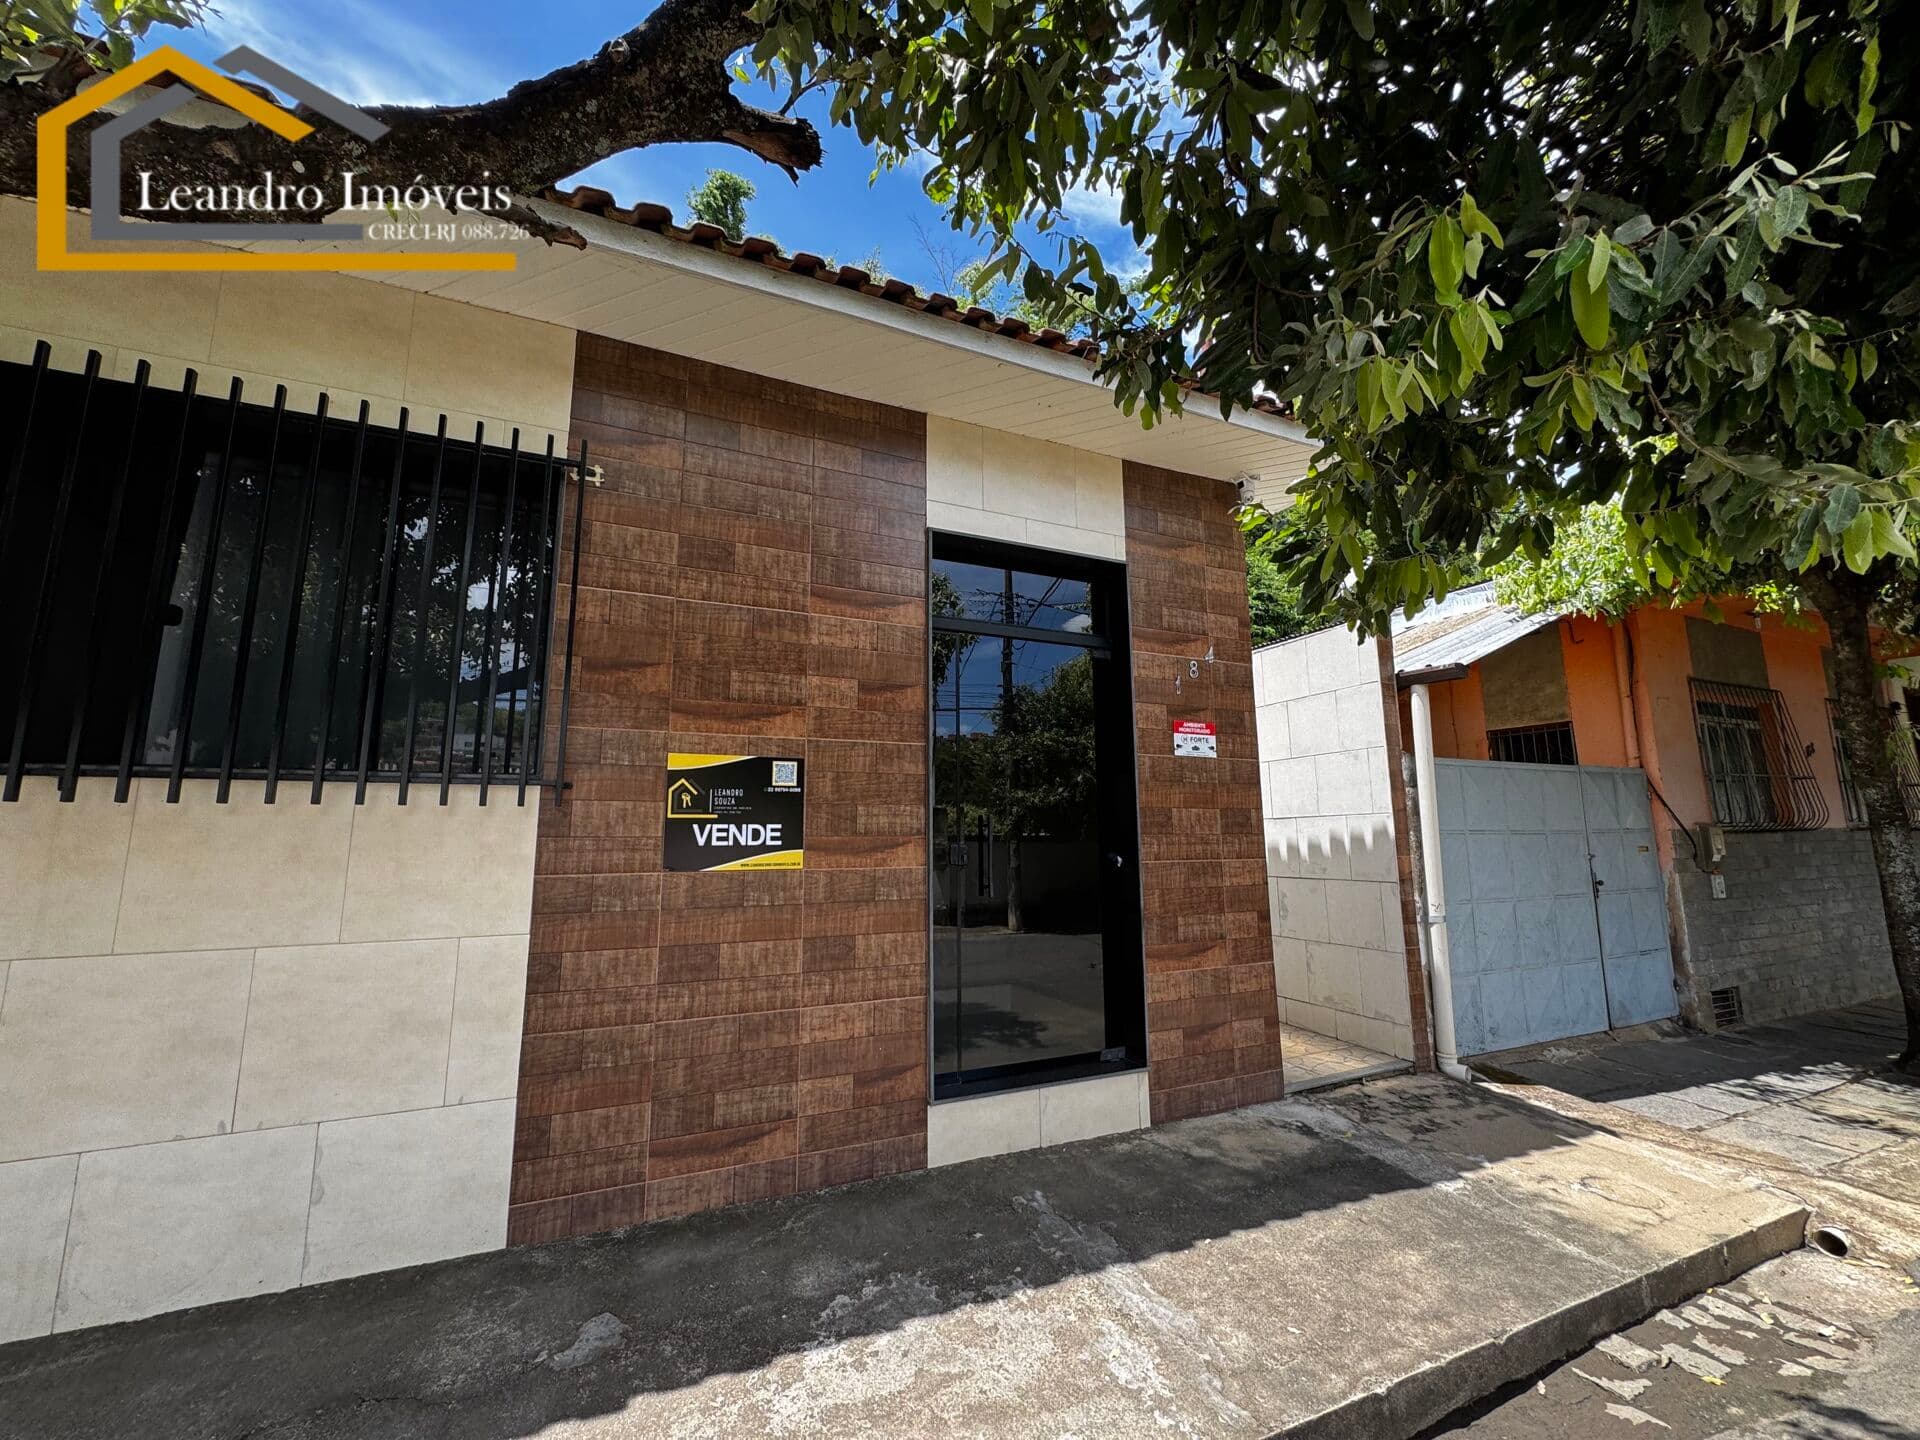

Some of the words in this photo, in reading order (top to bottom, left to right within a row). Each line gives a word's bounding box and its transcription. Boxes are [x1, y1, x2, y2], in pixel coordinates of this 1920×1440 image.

[714, 788, 744, 797] LEANDRO
[714, 797, 736, 805] SOUZA
[692, 823, 783, 847] VENDE
